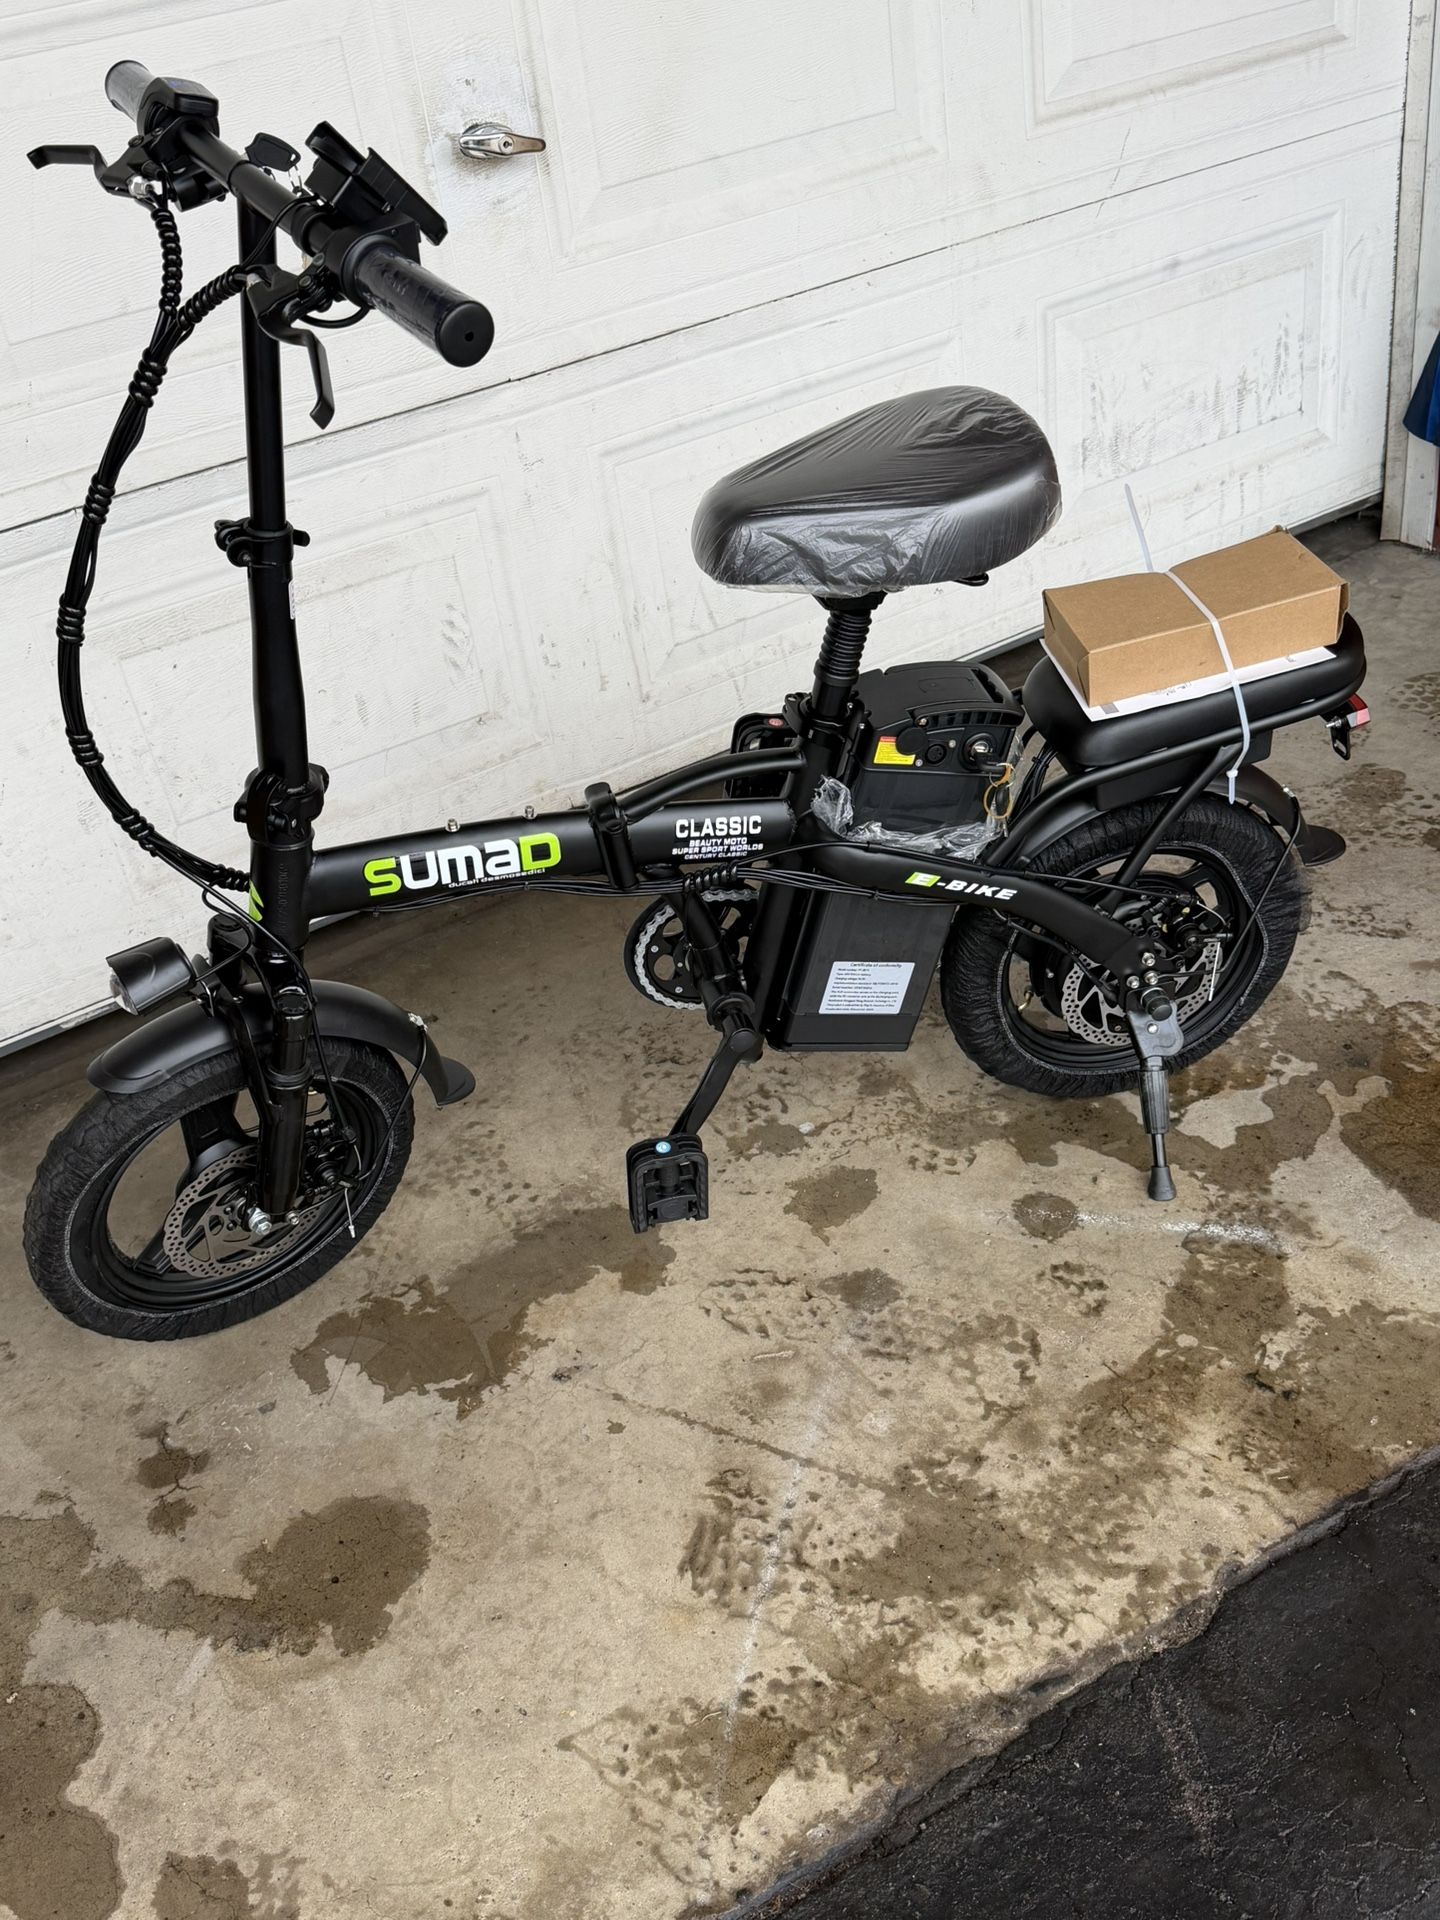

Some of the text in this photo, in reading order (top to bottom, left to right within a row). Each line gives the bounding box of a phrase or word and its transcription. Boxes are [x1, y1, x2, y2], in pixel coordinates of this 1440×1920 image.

[675, 815, 762, 838] CLASSIC
[672, 843, 764, 855] SUPER SPORT WORLDS
[689, 837, 748, 847] BEAUTY MOTO
[909, 872, 1018, 900] E-BIKE
